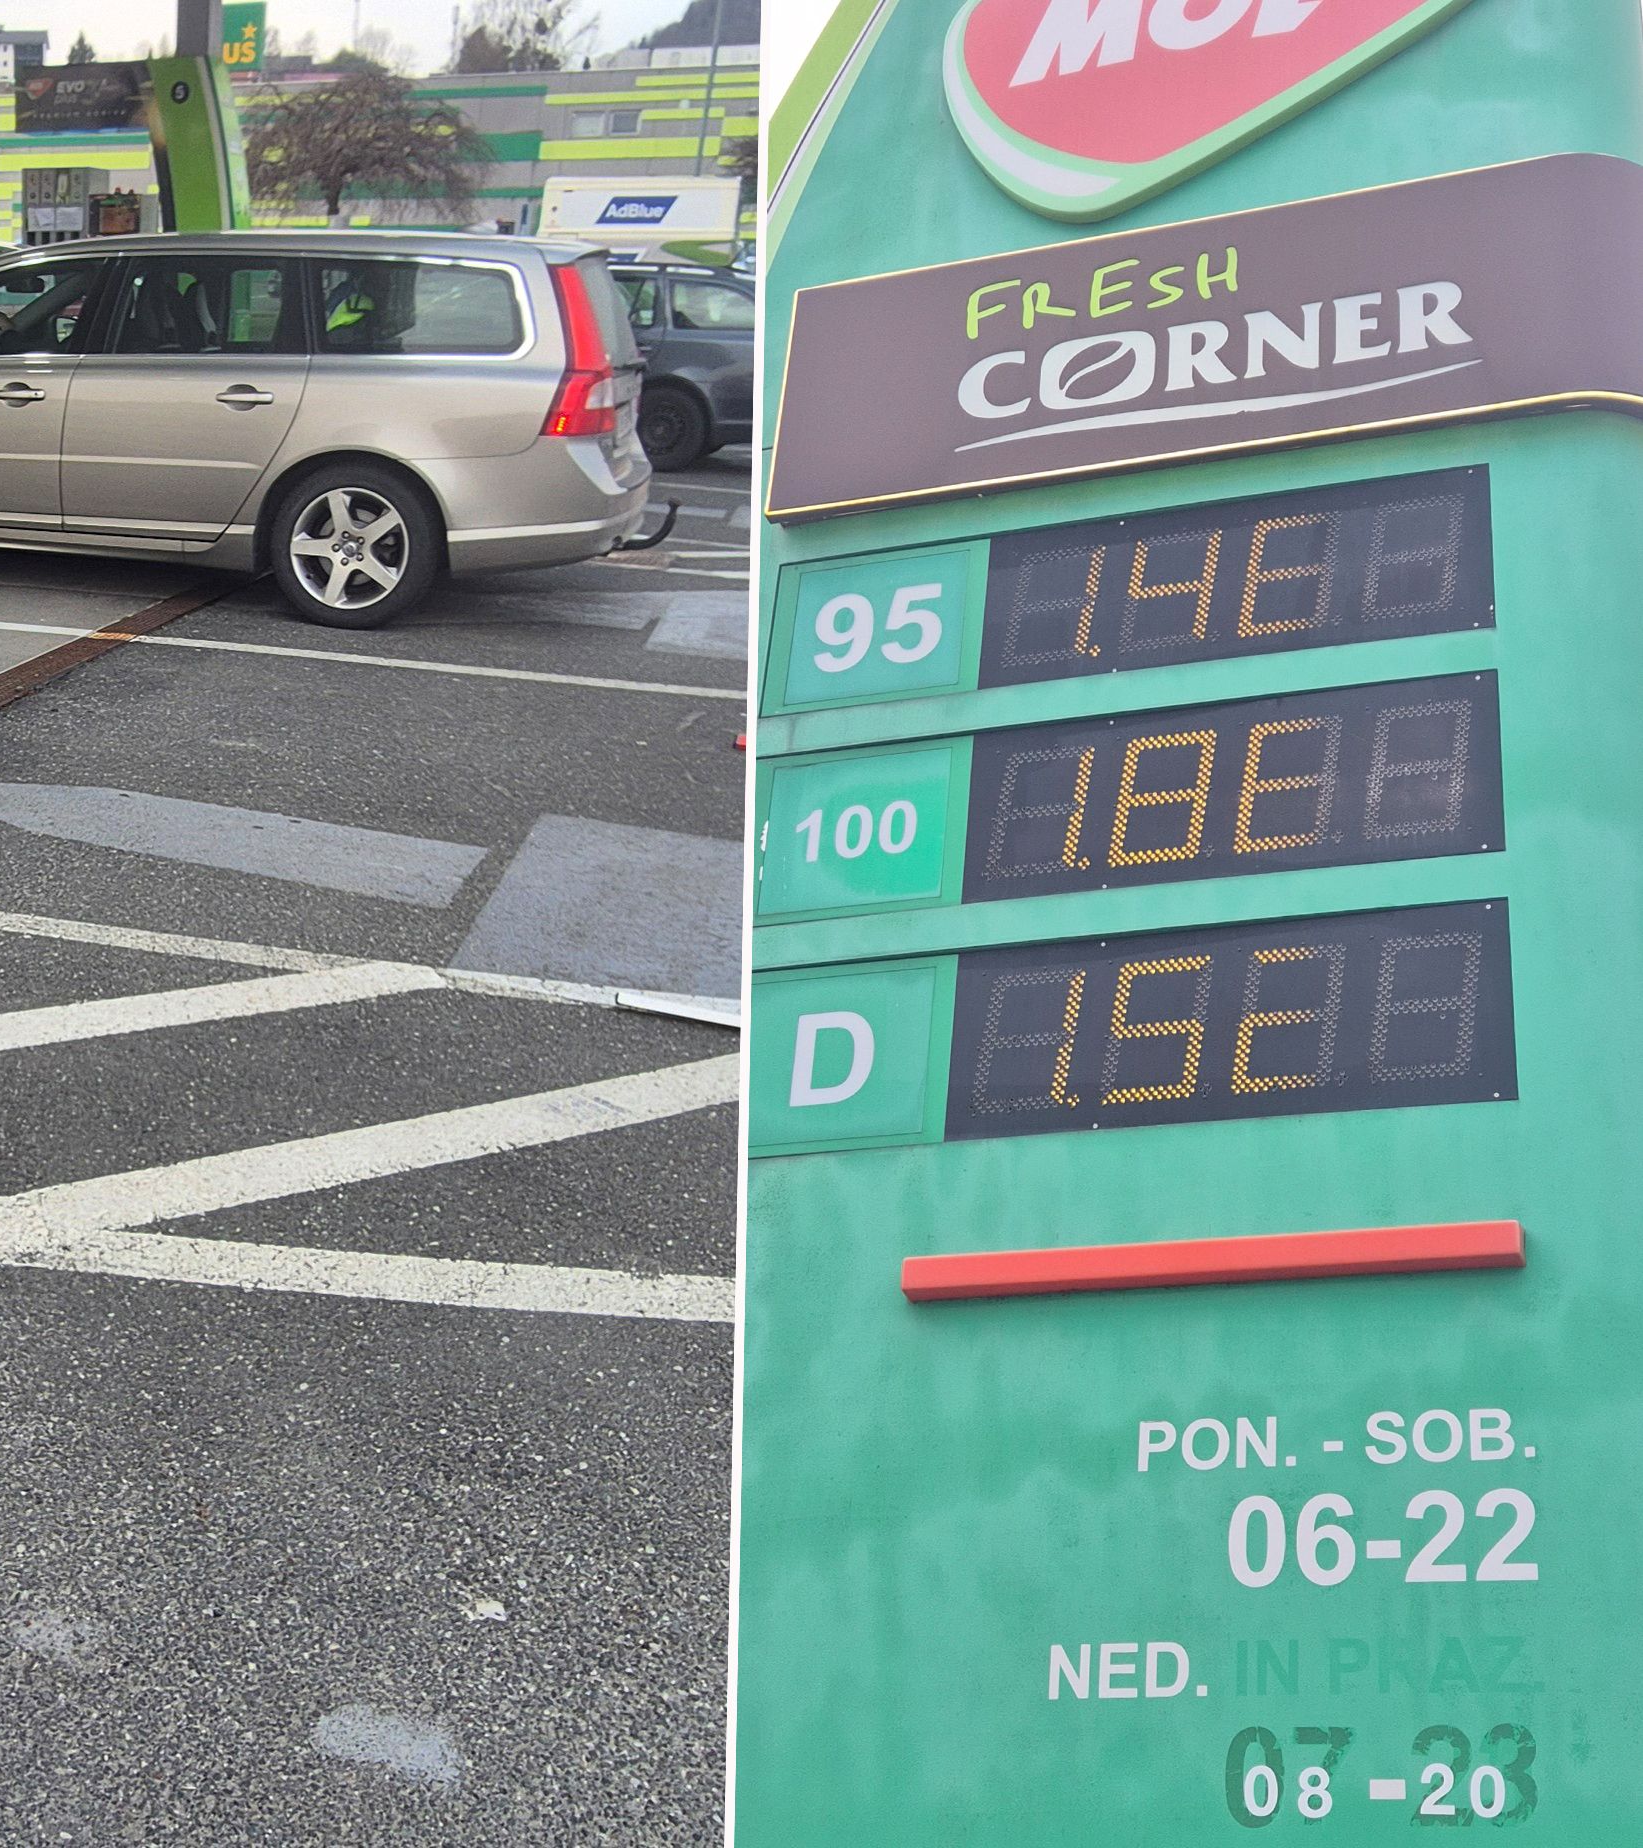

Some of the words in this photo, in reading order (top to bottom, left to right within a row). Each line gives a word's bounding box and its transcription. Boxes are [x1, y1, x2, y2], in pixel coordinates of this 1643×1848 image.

[57, 80, 85, 93] EVO
[605, 203, 666, 219] AdBlue
[964, 246, 1239, 340] FRESH
[956, 280, 1473, 420] CORNER
[813, 582, 944, 674] 95
[795, 800, 918, 863] 100
[788, 1010, 876, 1108] D
[1138, 1416, 1297, 1472] PON.
[1365, 1408, 1536, 1465] SOB.
[1228, 1488, 1539, 1587] 06-22
[1048, 1642, 1208, 1700] NED.
[1235, 1640, 1300, 1696] IN
